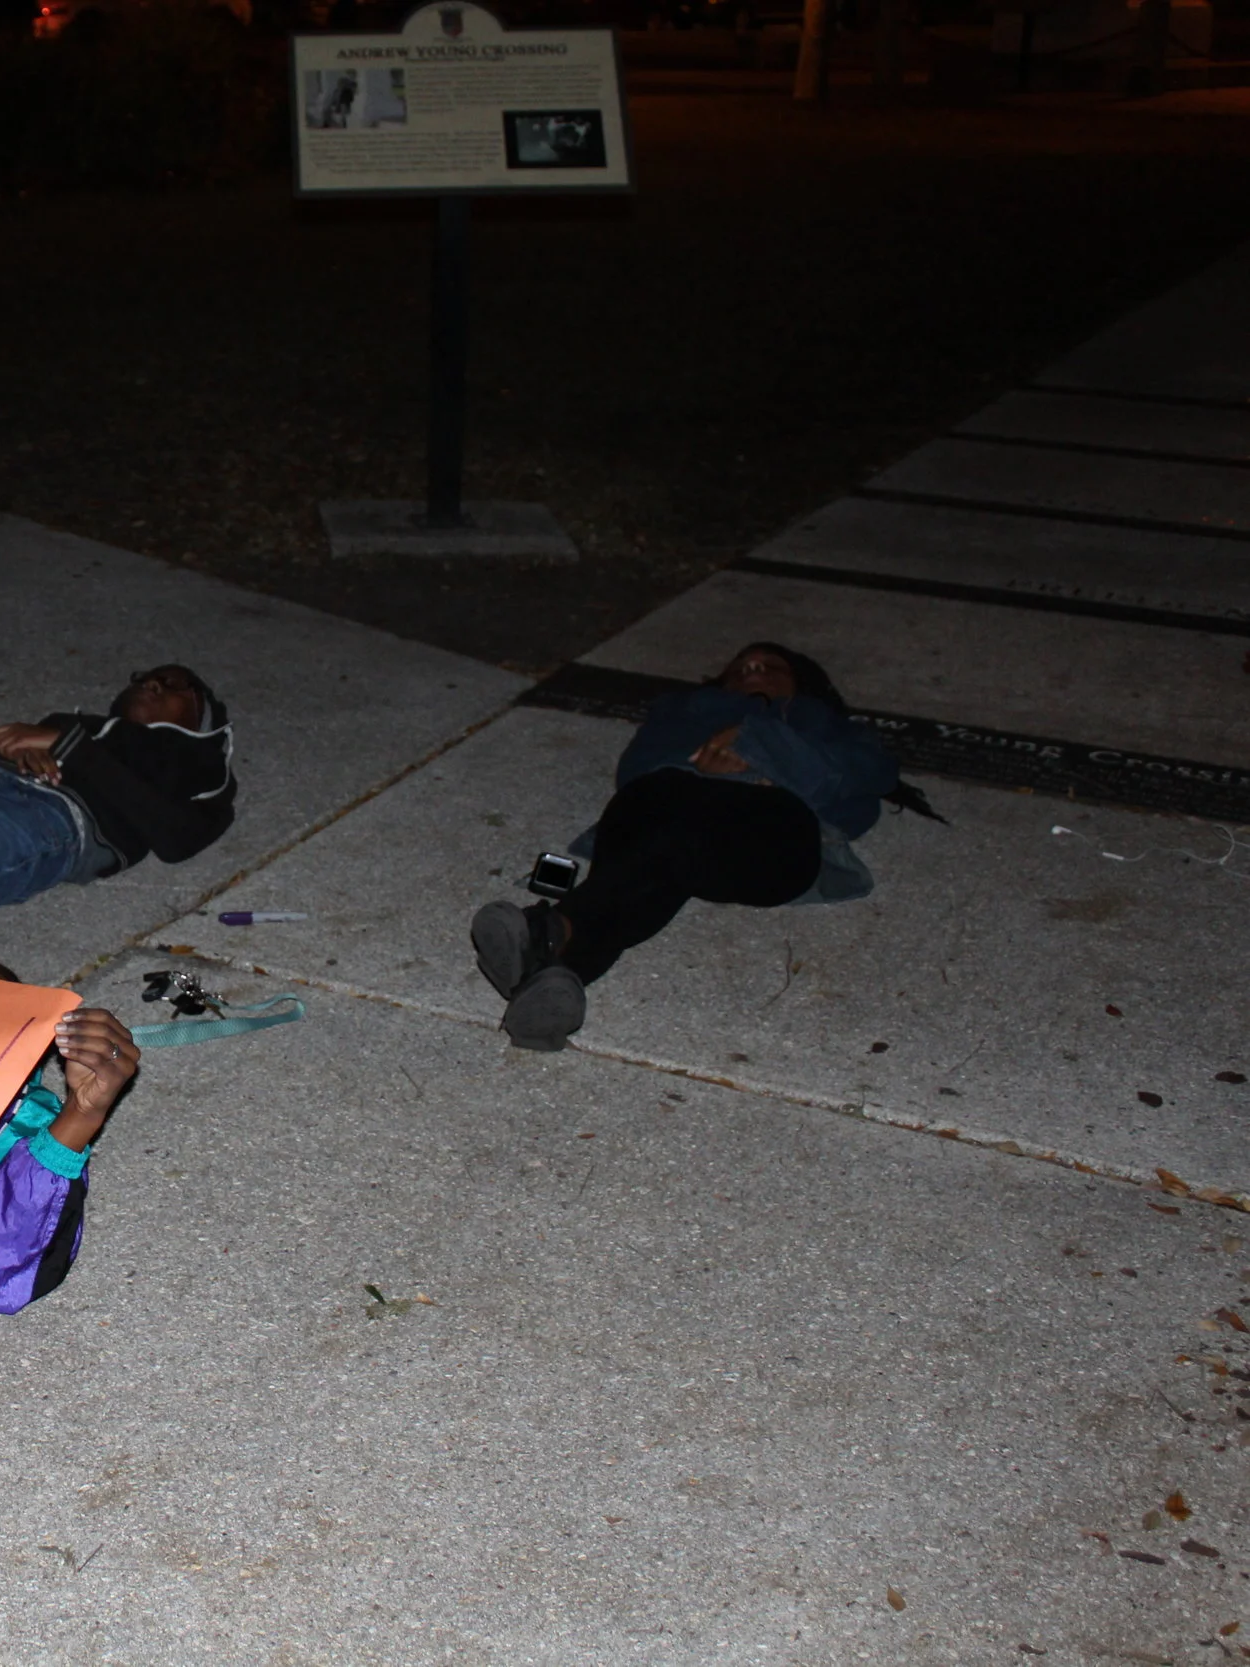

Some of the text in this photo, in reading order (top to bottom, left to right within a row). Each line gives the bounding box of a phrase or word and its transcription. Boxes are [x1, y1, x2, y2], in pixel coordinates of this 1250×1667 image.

[337, 43, 568, 59] ANDREW YOUNG CROSSING
